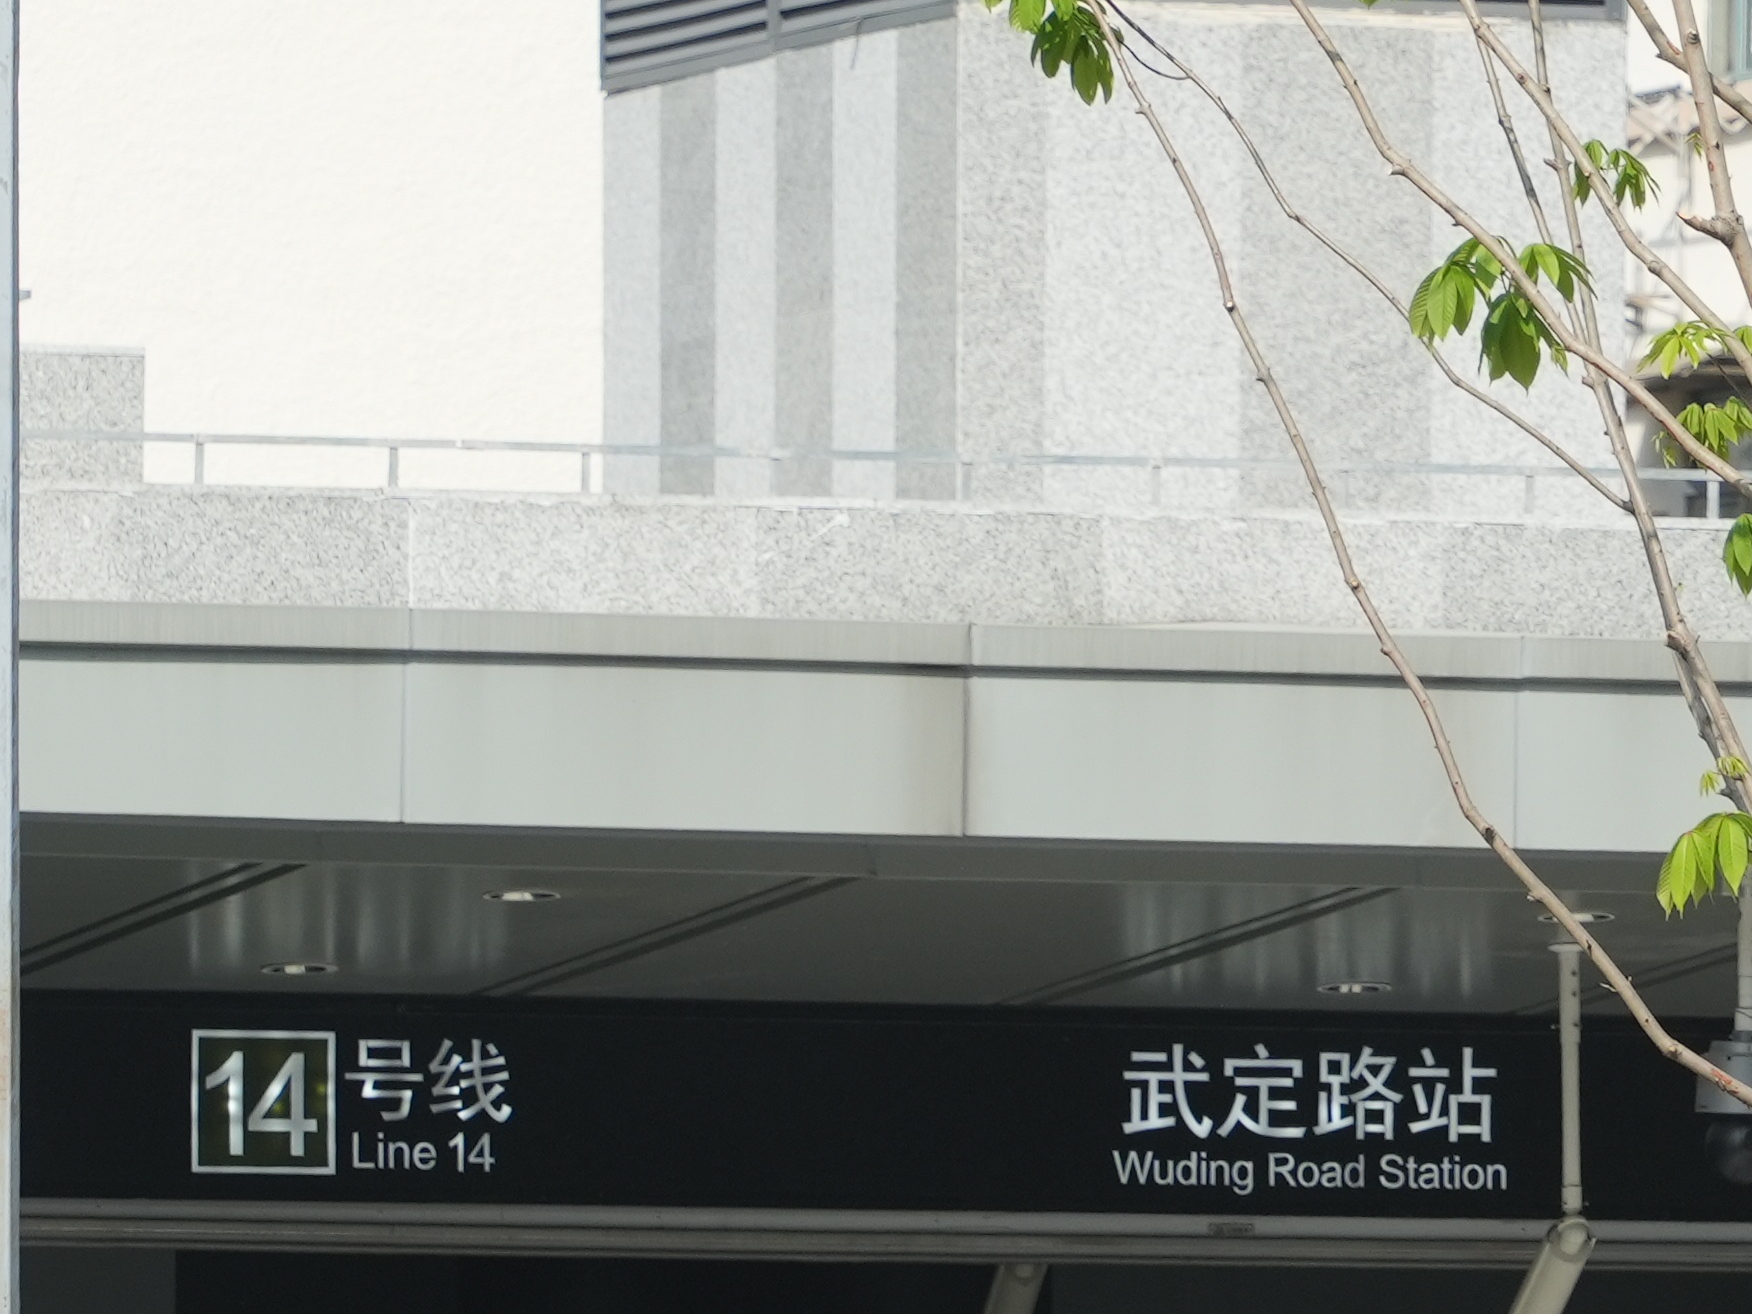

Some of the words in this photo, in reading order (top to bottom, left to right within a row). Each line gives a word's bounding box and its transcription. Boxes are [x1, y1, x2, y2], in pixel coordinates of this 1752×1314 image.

[203, 1048, 320, 1158] 14
[344, 1038, 513, 1124] 号线
[1121, 1043, 1498, 1143] 武定路站
[351, 1131, 438, 1171] Line
[448, 1131, 496, 1173] 14
[1112, 1150, 1254, 1196] Wuding
[1268, 1152, 1365, 1189] Road
[1378, 1154, 1508, 1191] Station
